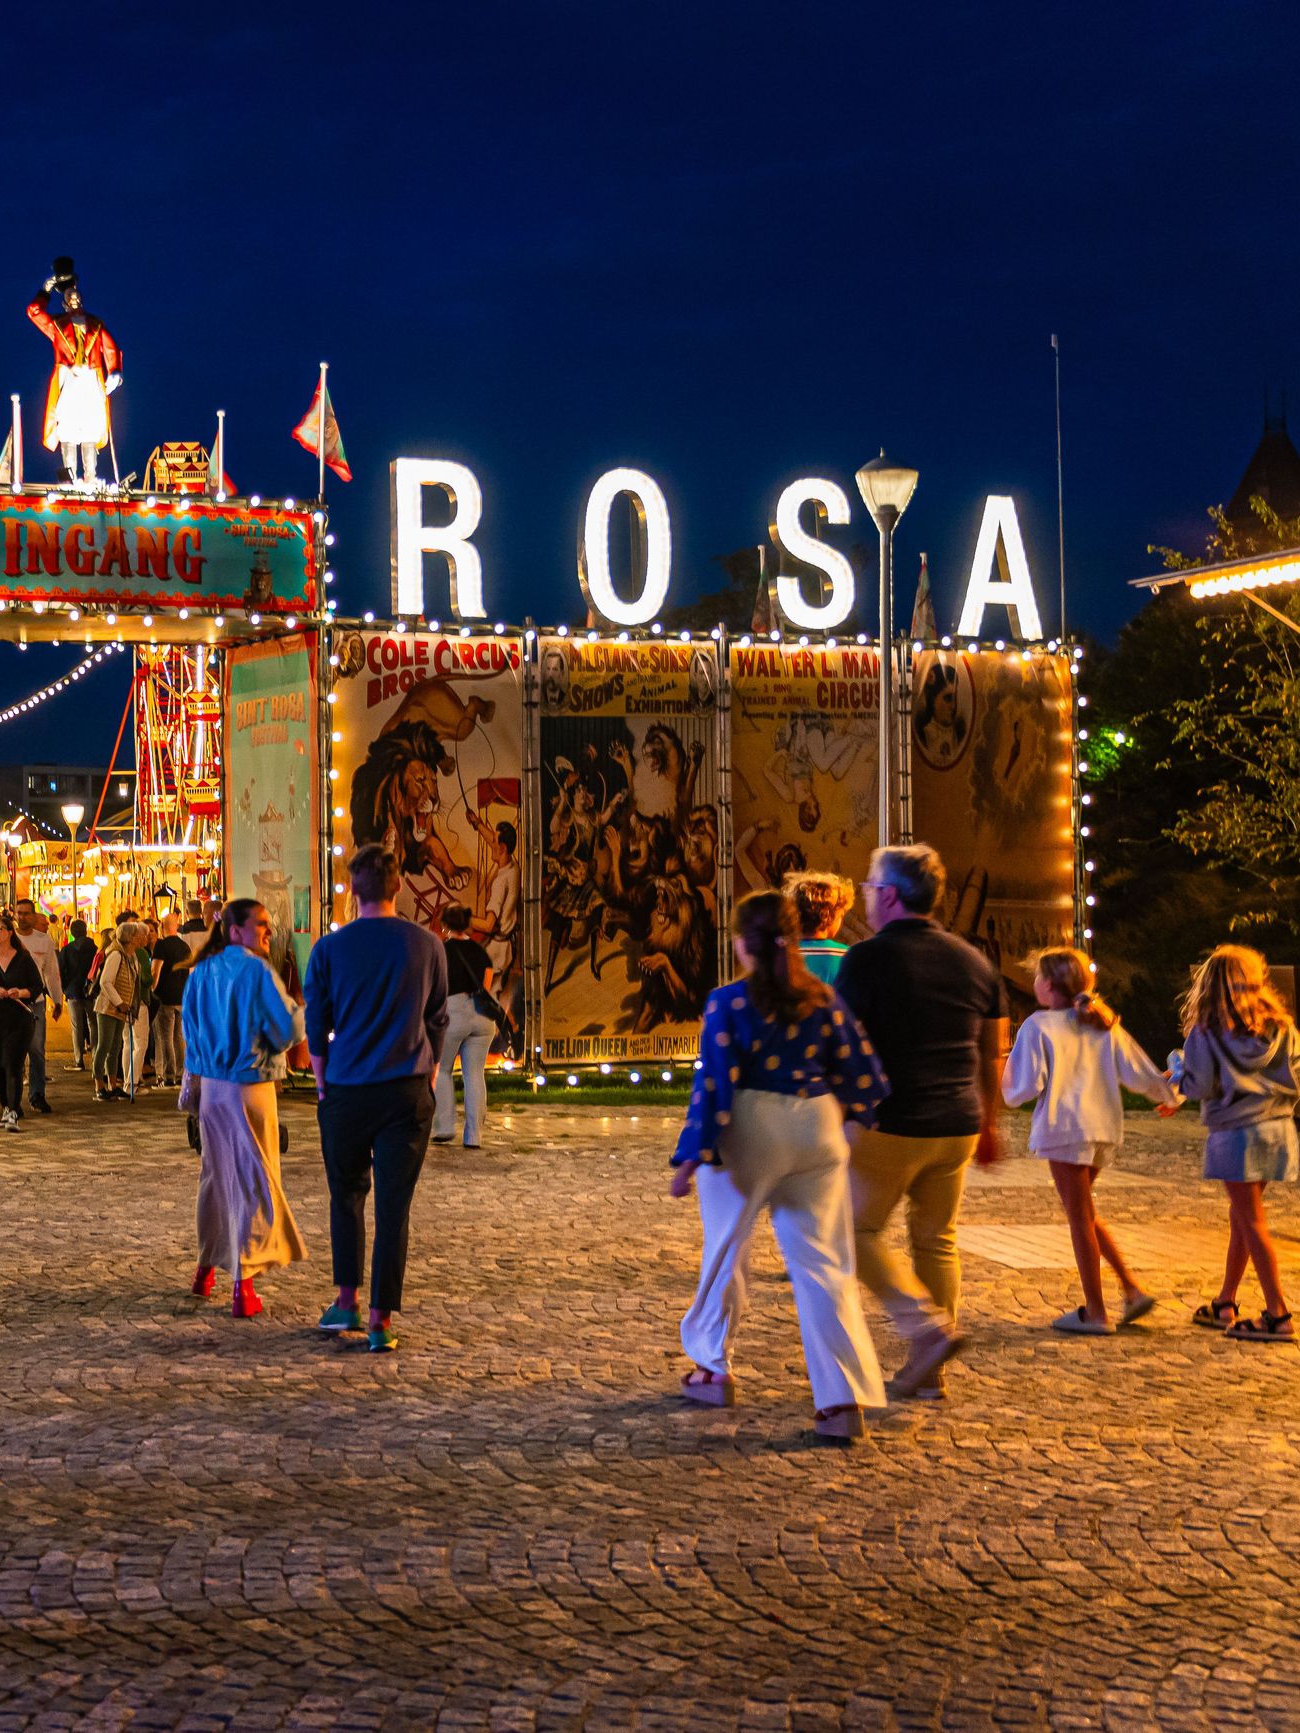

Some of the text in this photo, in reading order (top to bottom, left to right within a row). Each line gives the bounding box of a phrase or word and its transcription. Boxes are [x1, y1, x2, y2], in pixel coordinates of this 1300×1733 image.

[2, 517, 207, 584] INGANG
[390, 457, 1043, 642] ROSA
[366, 636, 520, 675] COLE CIRCUS
[737, 650, 815, 678] WALTER
[366, 667, 428, 709] BROS
[569, 673, 624, 713] SHOWS
[639, 679, 677, 697] ANIMAL
[545, 1036, 627, 1058] THE LION QUEEN
